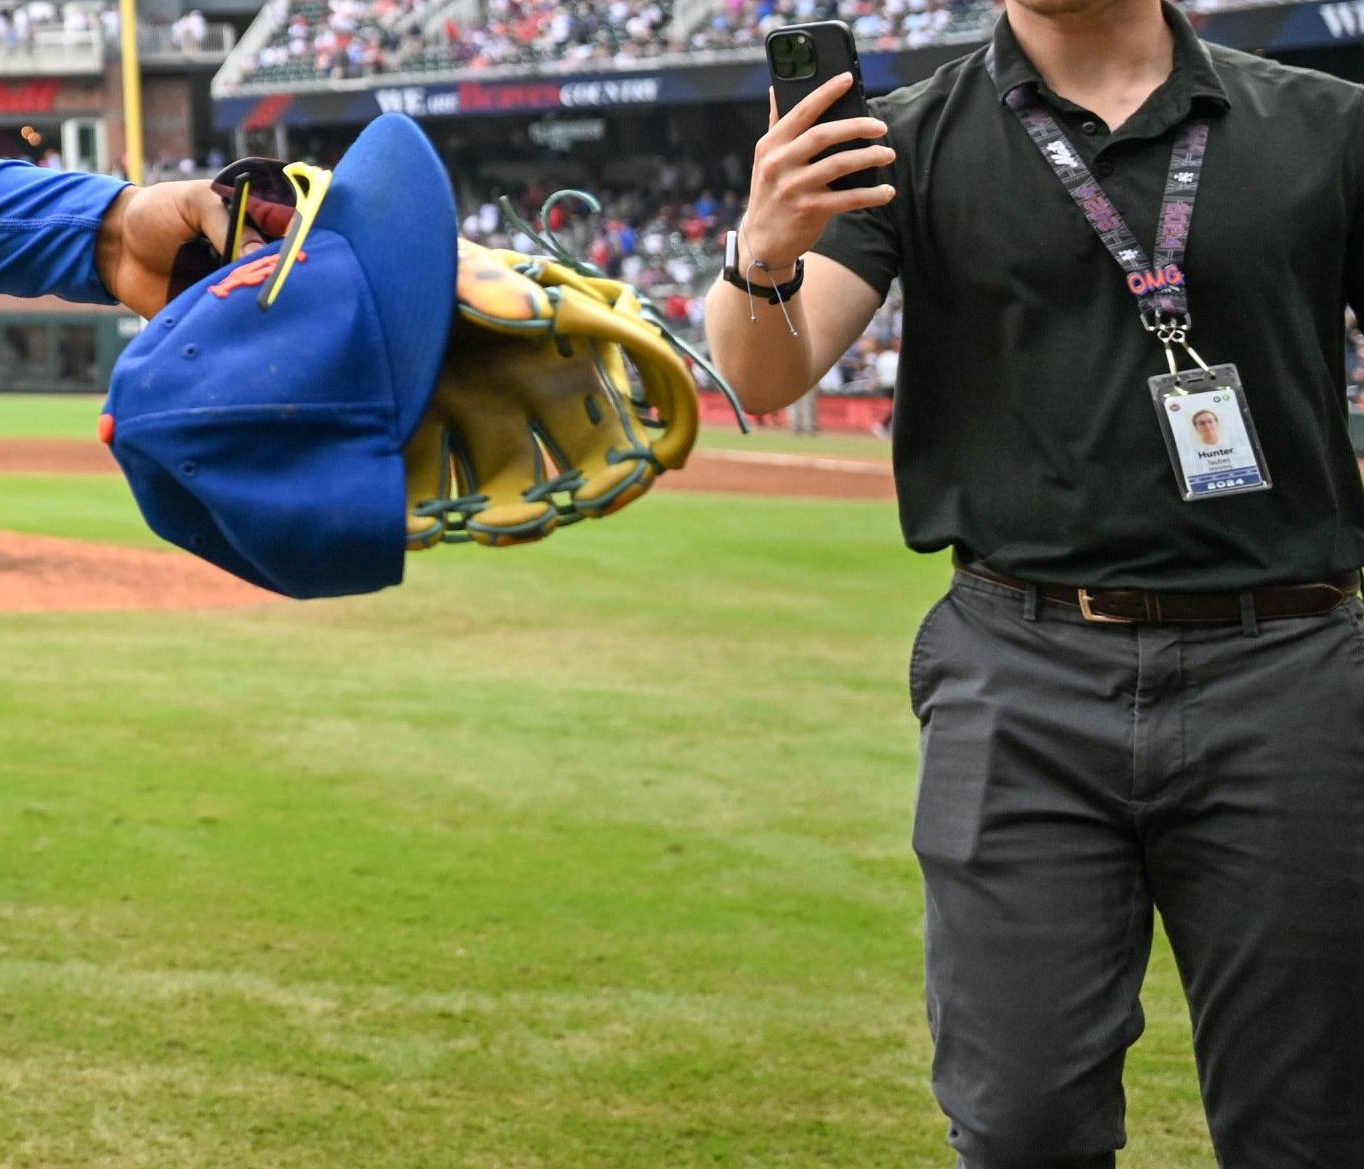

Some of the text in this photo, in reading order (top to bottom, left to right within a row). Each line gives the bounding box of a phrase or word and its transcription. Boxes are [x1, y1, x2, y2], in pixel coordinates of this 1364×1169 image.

[375, 85, 426, 115] WE
[1127, 264, 1184, 295] OMG
[1198, 448, 1234, 460] Hunter
[1207, 478, 1245, 490] 2024
